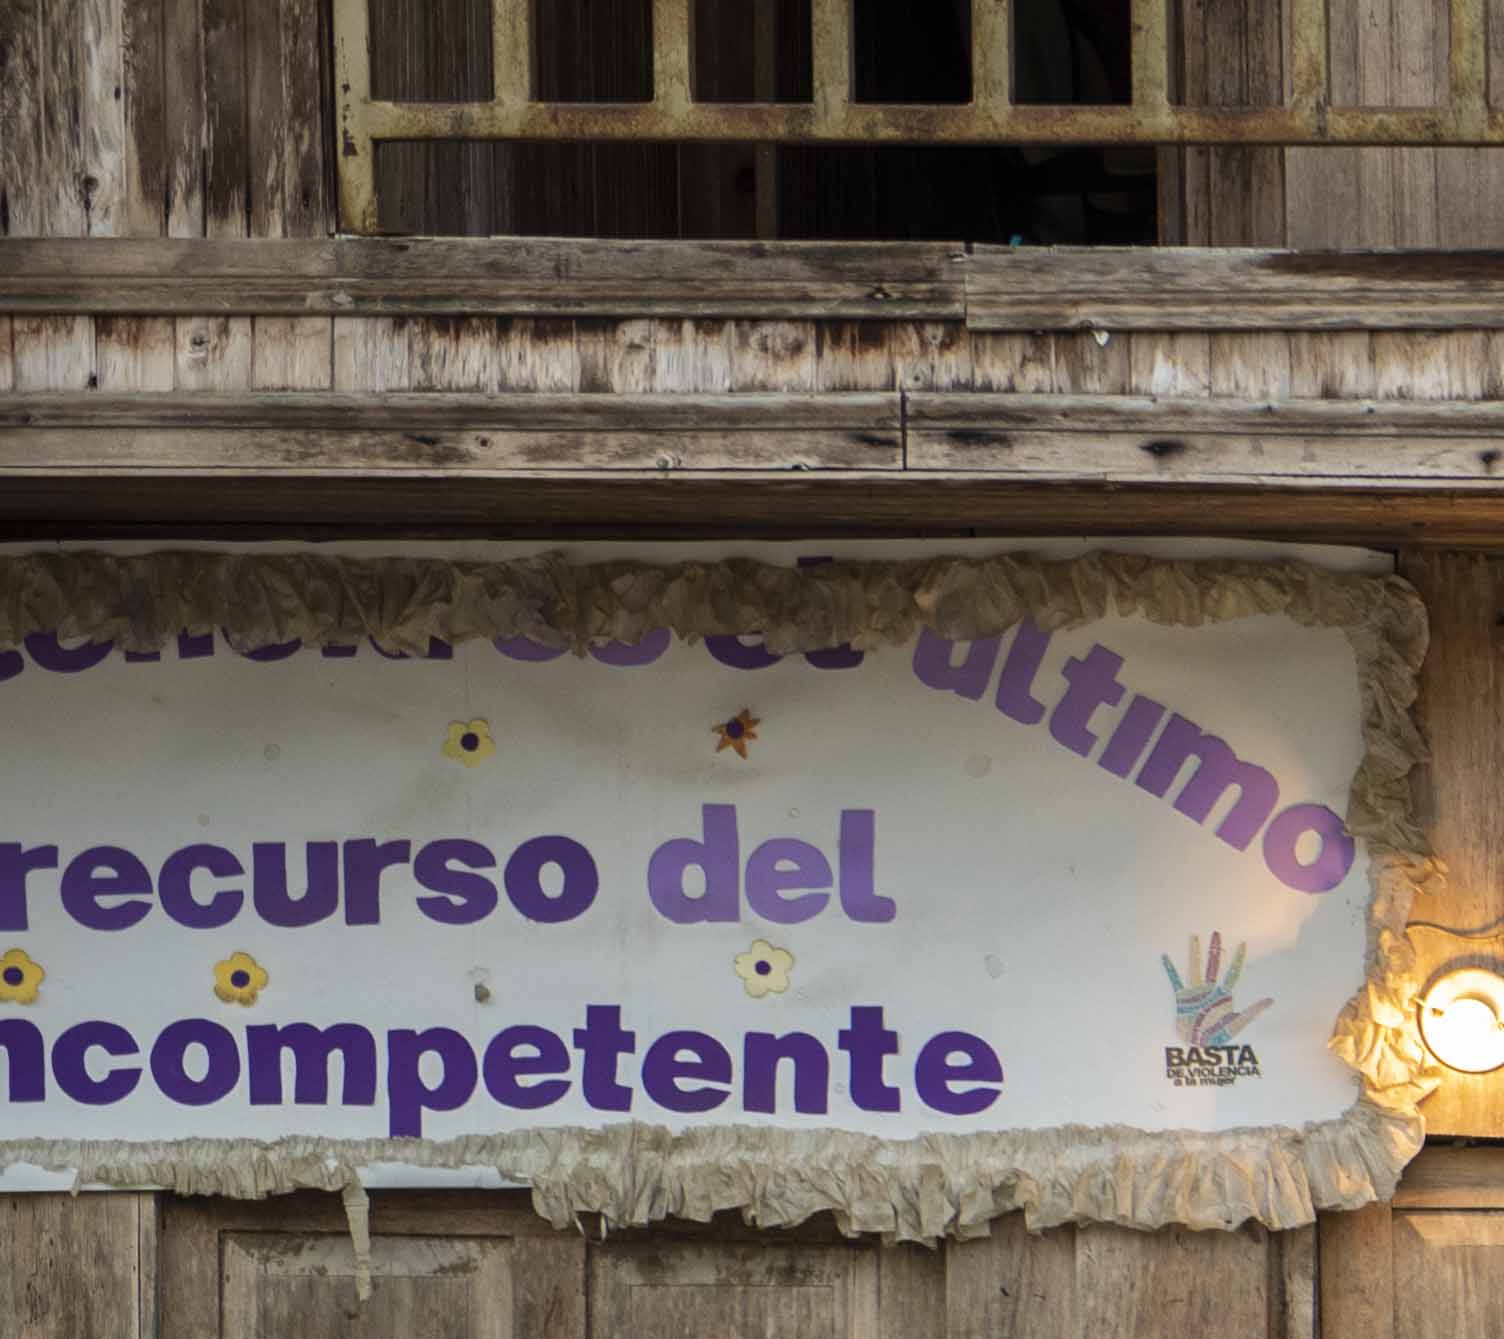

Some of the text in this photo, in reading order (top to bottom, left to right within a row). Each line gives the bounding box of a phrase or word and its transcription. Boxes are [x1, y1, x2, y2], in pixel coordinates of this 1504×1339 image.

[0, 803, 897, 932] recurso del
[1164, 1044, 1259, 1067] BASTA
